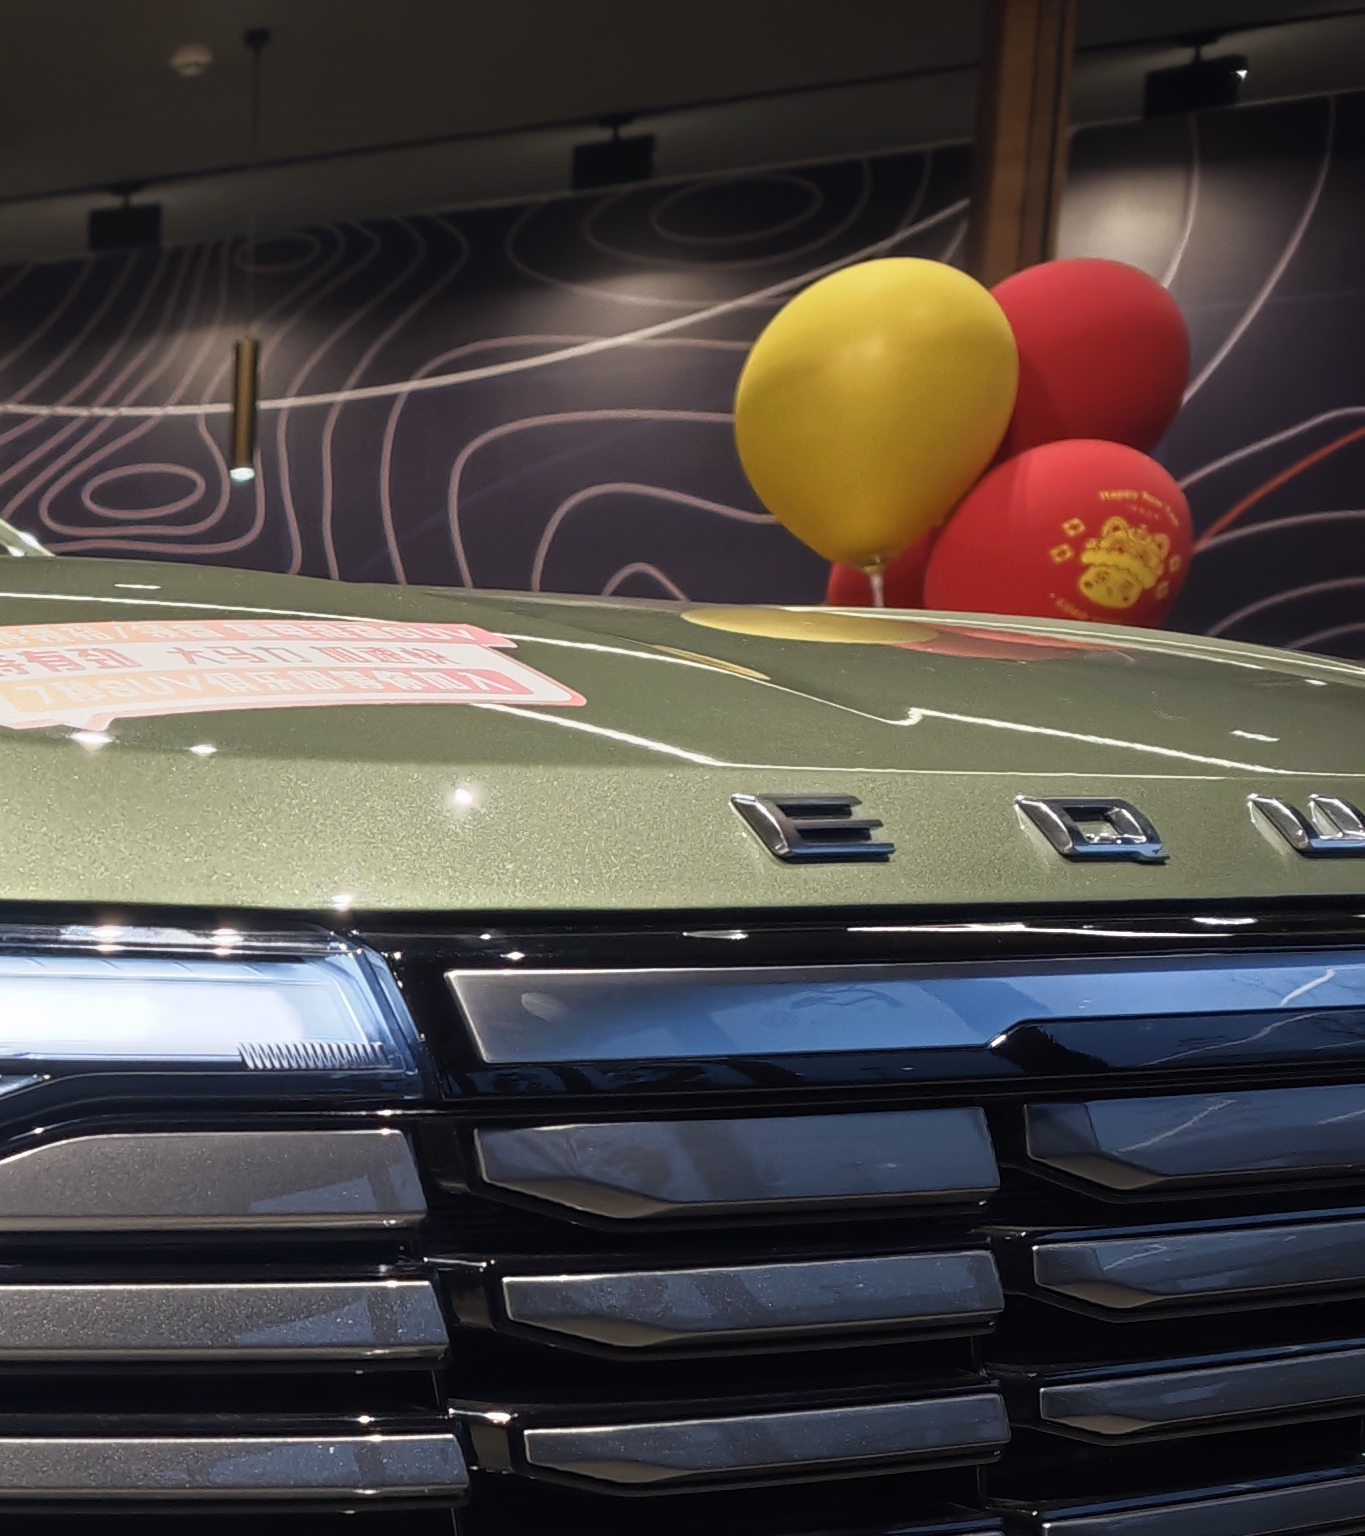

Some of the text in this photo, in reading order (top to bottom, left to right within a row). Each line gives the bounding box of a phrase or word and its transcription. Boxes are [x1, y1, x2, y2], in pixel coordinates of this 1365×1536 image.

[167, 645, 318, 667] 大马力
[315, 646, 462, 667] 加速快
